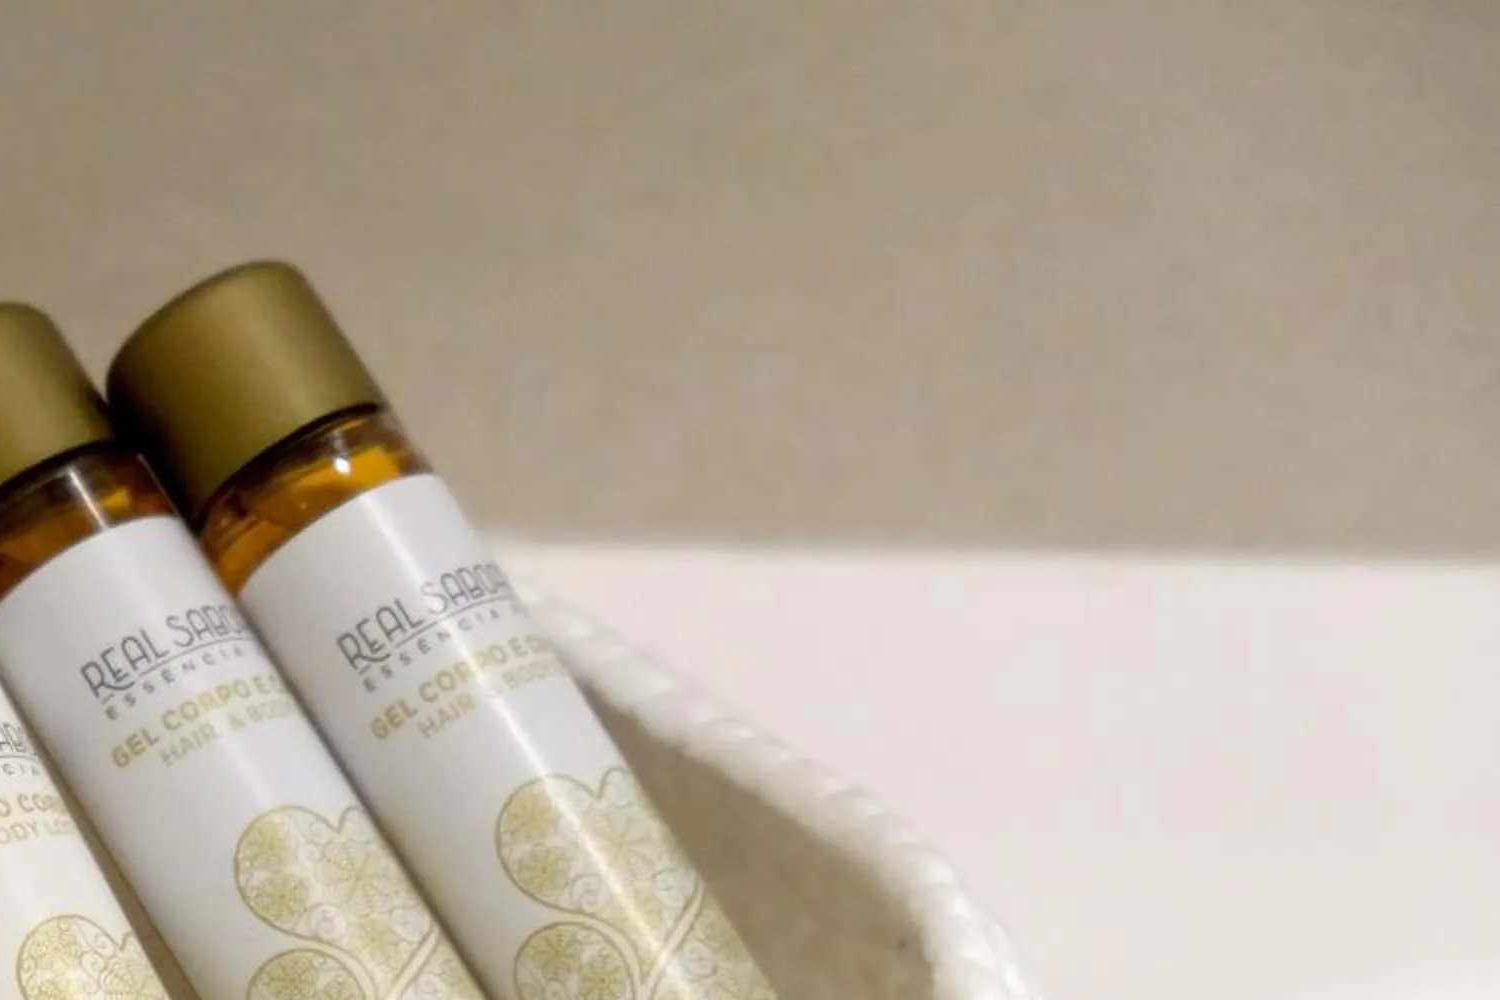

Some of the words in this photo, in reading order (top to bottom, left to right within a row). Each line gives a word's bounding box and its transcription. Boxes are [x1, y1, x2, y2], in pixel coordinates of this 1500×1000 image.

[79, 629, 170, 699] REAL
[336, 599, 425, 671] REAL
[111, 728, 161, 768] GEL
[161, 679, 251, 731] CORPO
[369, 699, 420, 741] GEL
[417, 694, 477, 739] HAIR
